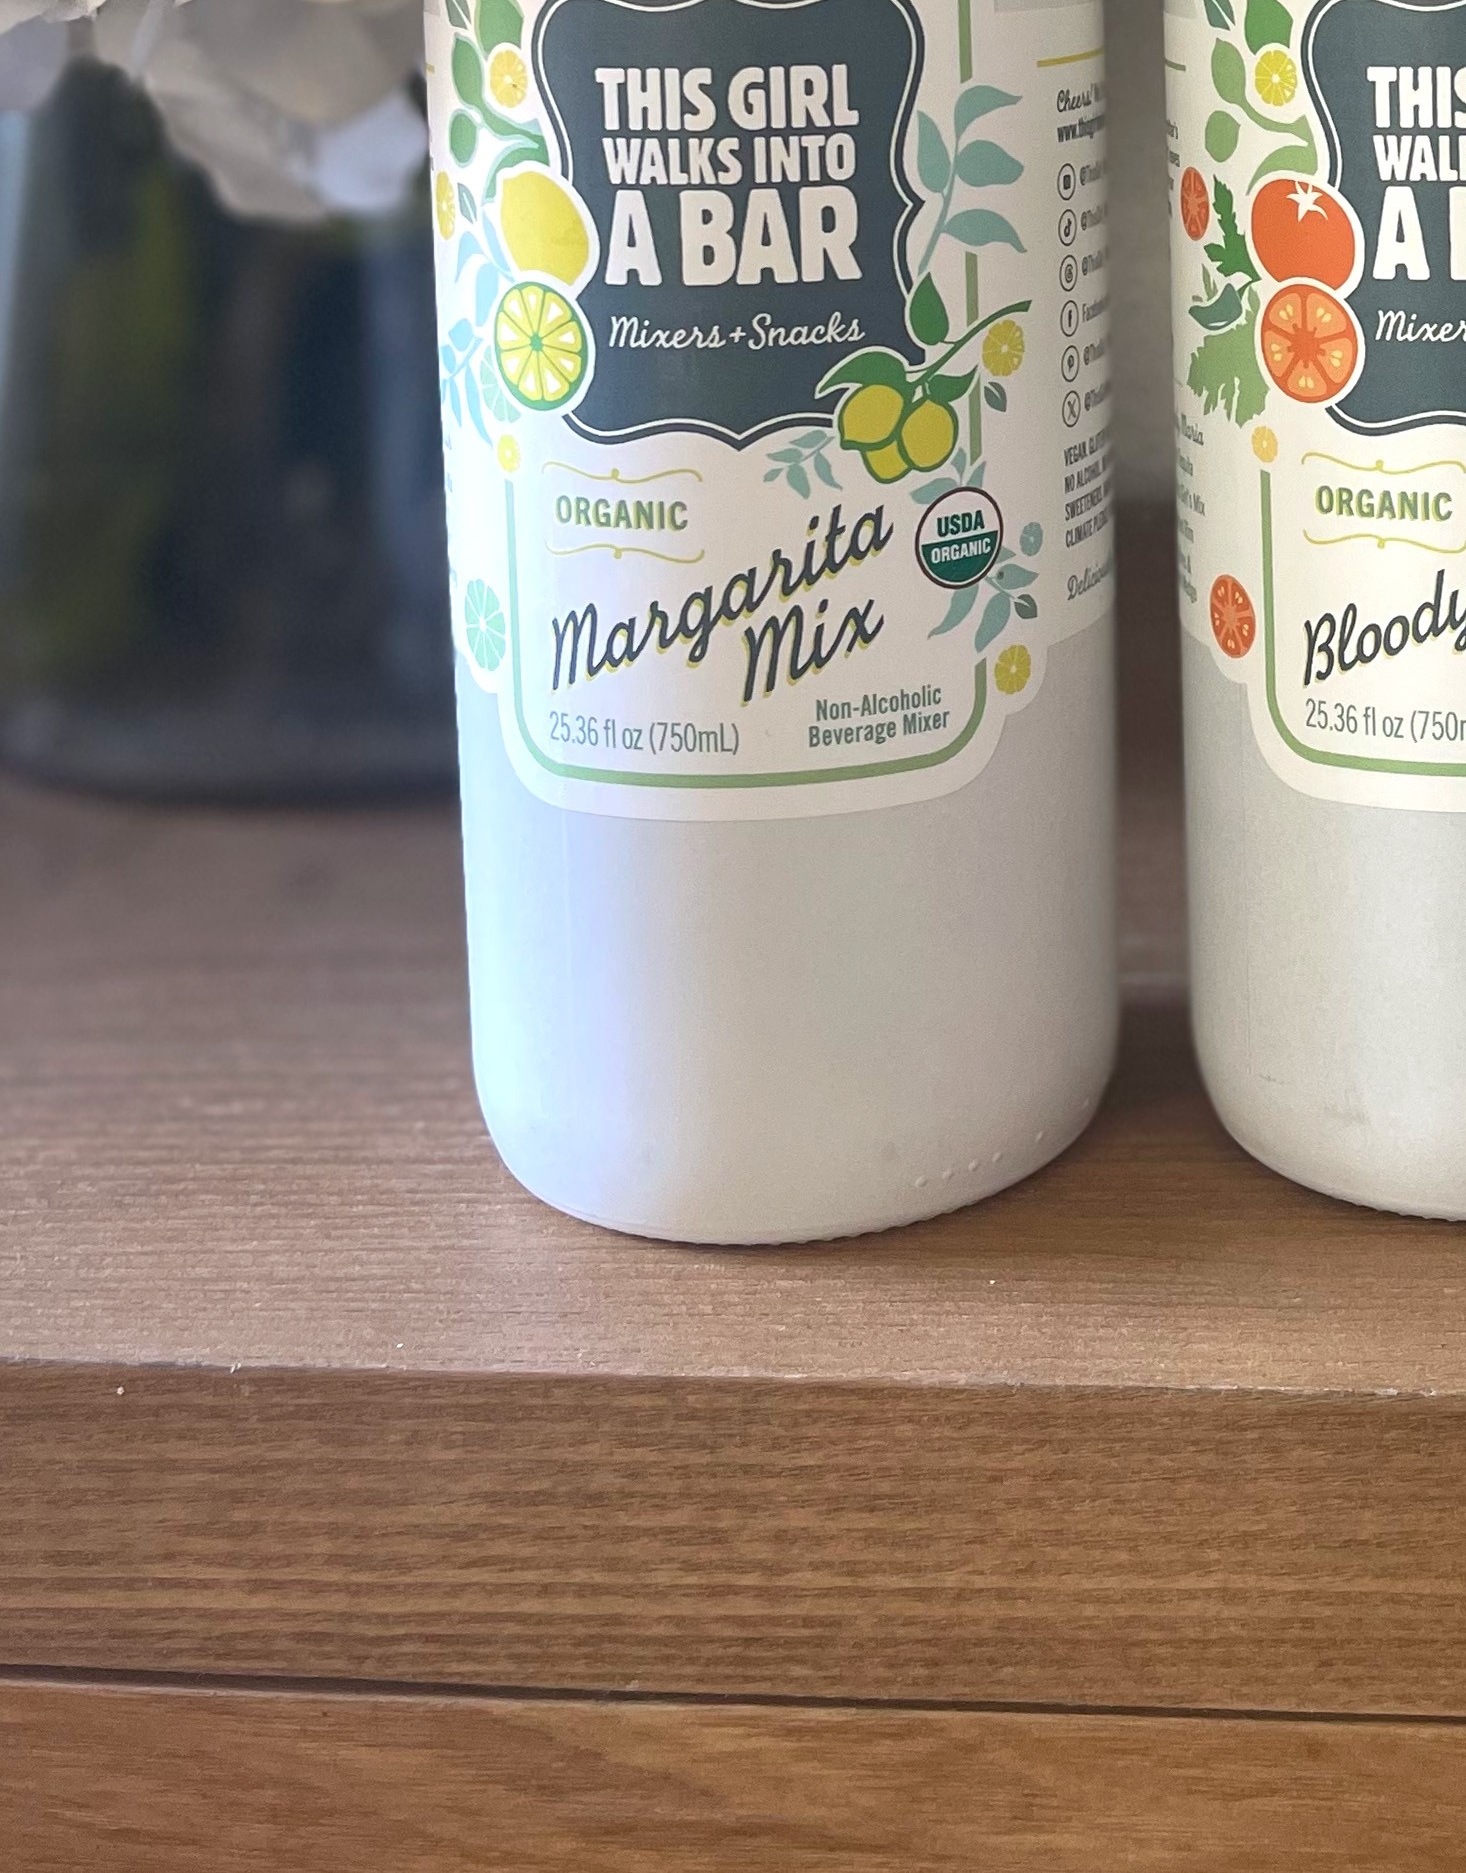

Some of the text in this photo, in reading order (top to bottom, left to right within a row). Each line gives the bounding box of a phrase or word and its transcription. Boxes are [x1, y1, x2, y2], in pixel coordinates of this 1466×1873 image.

[594, 63, 861, 132] THIS GIRL
[602, 132, 856, 186] WALKS INTO
[603, 184, 863, 287] A BAR
[1372, 185, 1431, 281] A
[554, 494, 689, 533] ORGANIC
[936, 509, 986, 540] USDA
[1314, 484, 1454, 523] ORGANIC
[930, 536, 992, 566] ORGANIC
[550, 503, 895, 695] Margarita
[741, 597, 886, 708] Mix
[815, 683, 942, 722] Non-Alcoholic
[1304, 696, 1359, 734] 25.36
[1362, 706, 1377, 737] fl
[1381, 715, 1405, 740] oz
[548, 710, 740, 756] 25.36 fl oz (750mL)
[808, 708, 951, 749] Beverage Mixer
